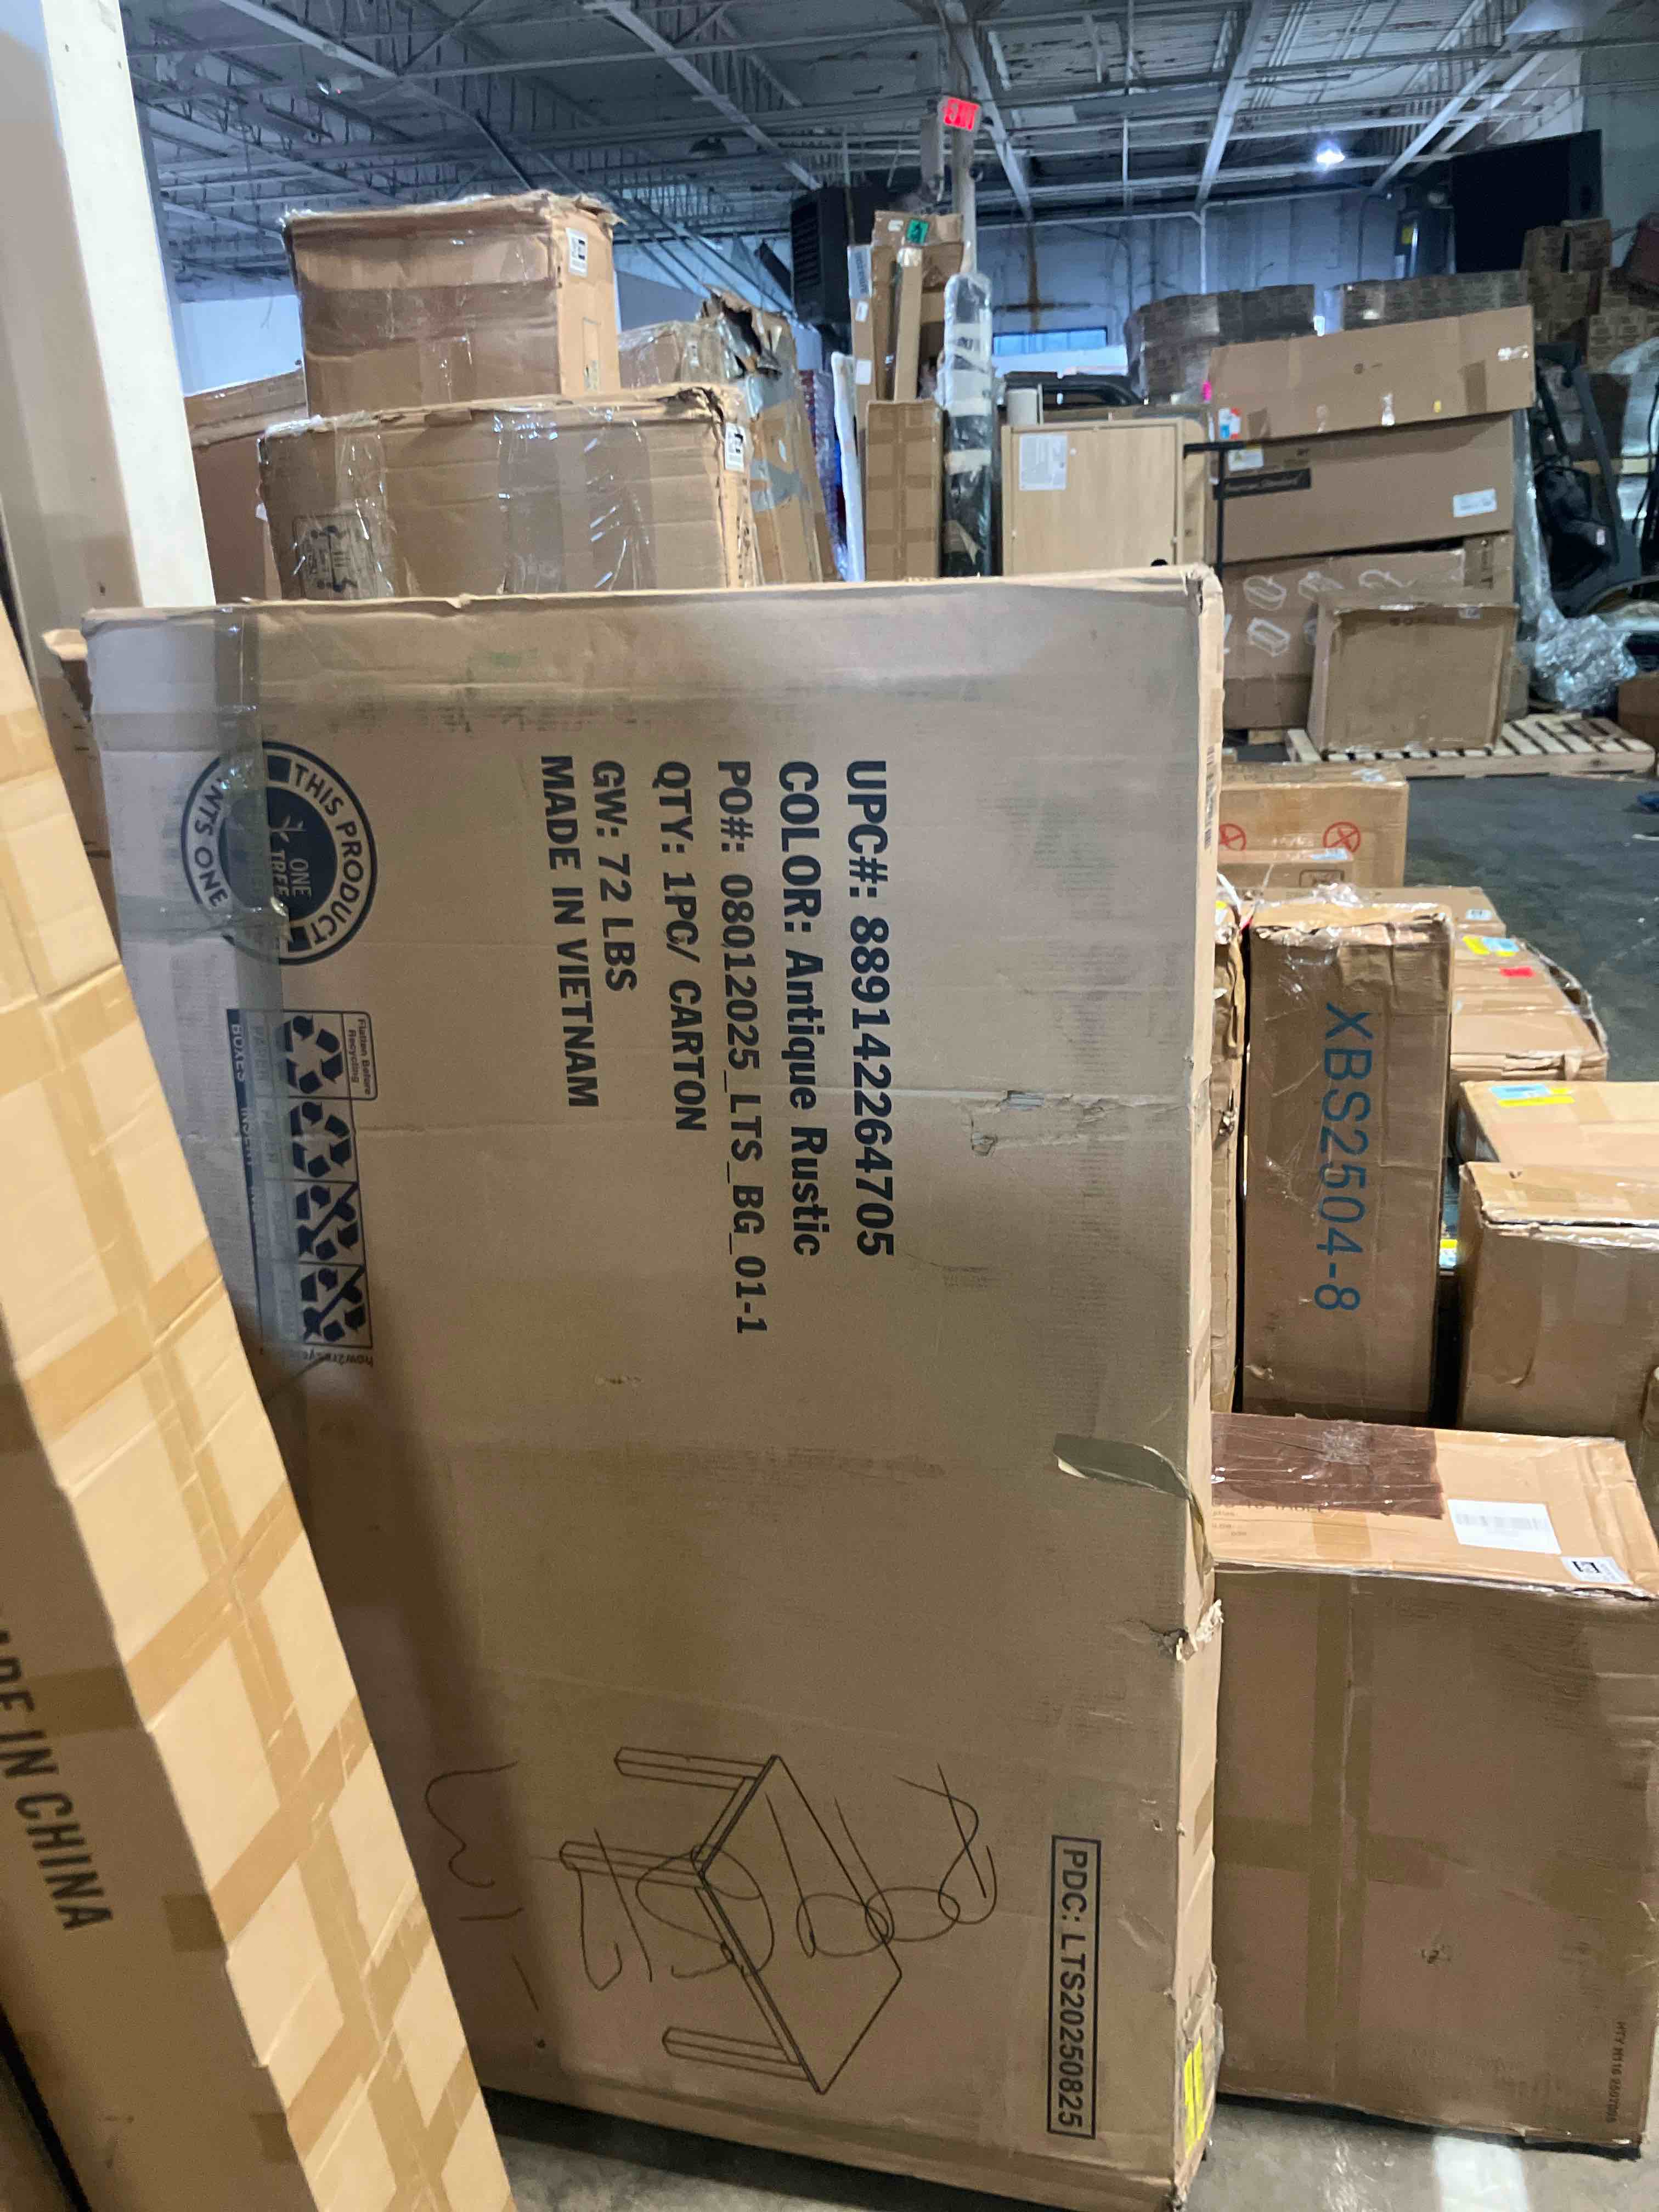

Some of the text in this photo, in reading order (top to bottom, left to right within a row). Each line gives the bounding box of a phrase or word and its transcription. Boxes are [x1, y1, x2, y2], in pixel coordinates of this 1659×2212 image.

[194, 846, 228, 907] ONE
[289, 763, 364, 945] THIS PRODUCT
[289, 857, 312, 898] ONE
[592, 760, 637, 991] GW: 72 LBS
[718, 761, 754, 853] PO#:
[540, 755, 599, 1107] MADE IN VIETNAM
[652, 761, 708, 1131] QTY: 1PC/ CARTON
[779, 761, 830, 1256] COLOR: Antique Rustic
[847, 760, 895, 1256] UPC#: 889142264705
[357, 1018, 367, 1056] Flatten
[1313, 1002, 1374, 1311] XBS2504-8
[0, 1731, 59, 1780] IN
[15, 1791, 114, 1931] CHINA
[1058, 1849, 1088, 2128] PDC: LTS20250825
